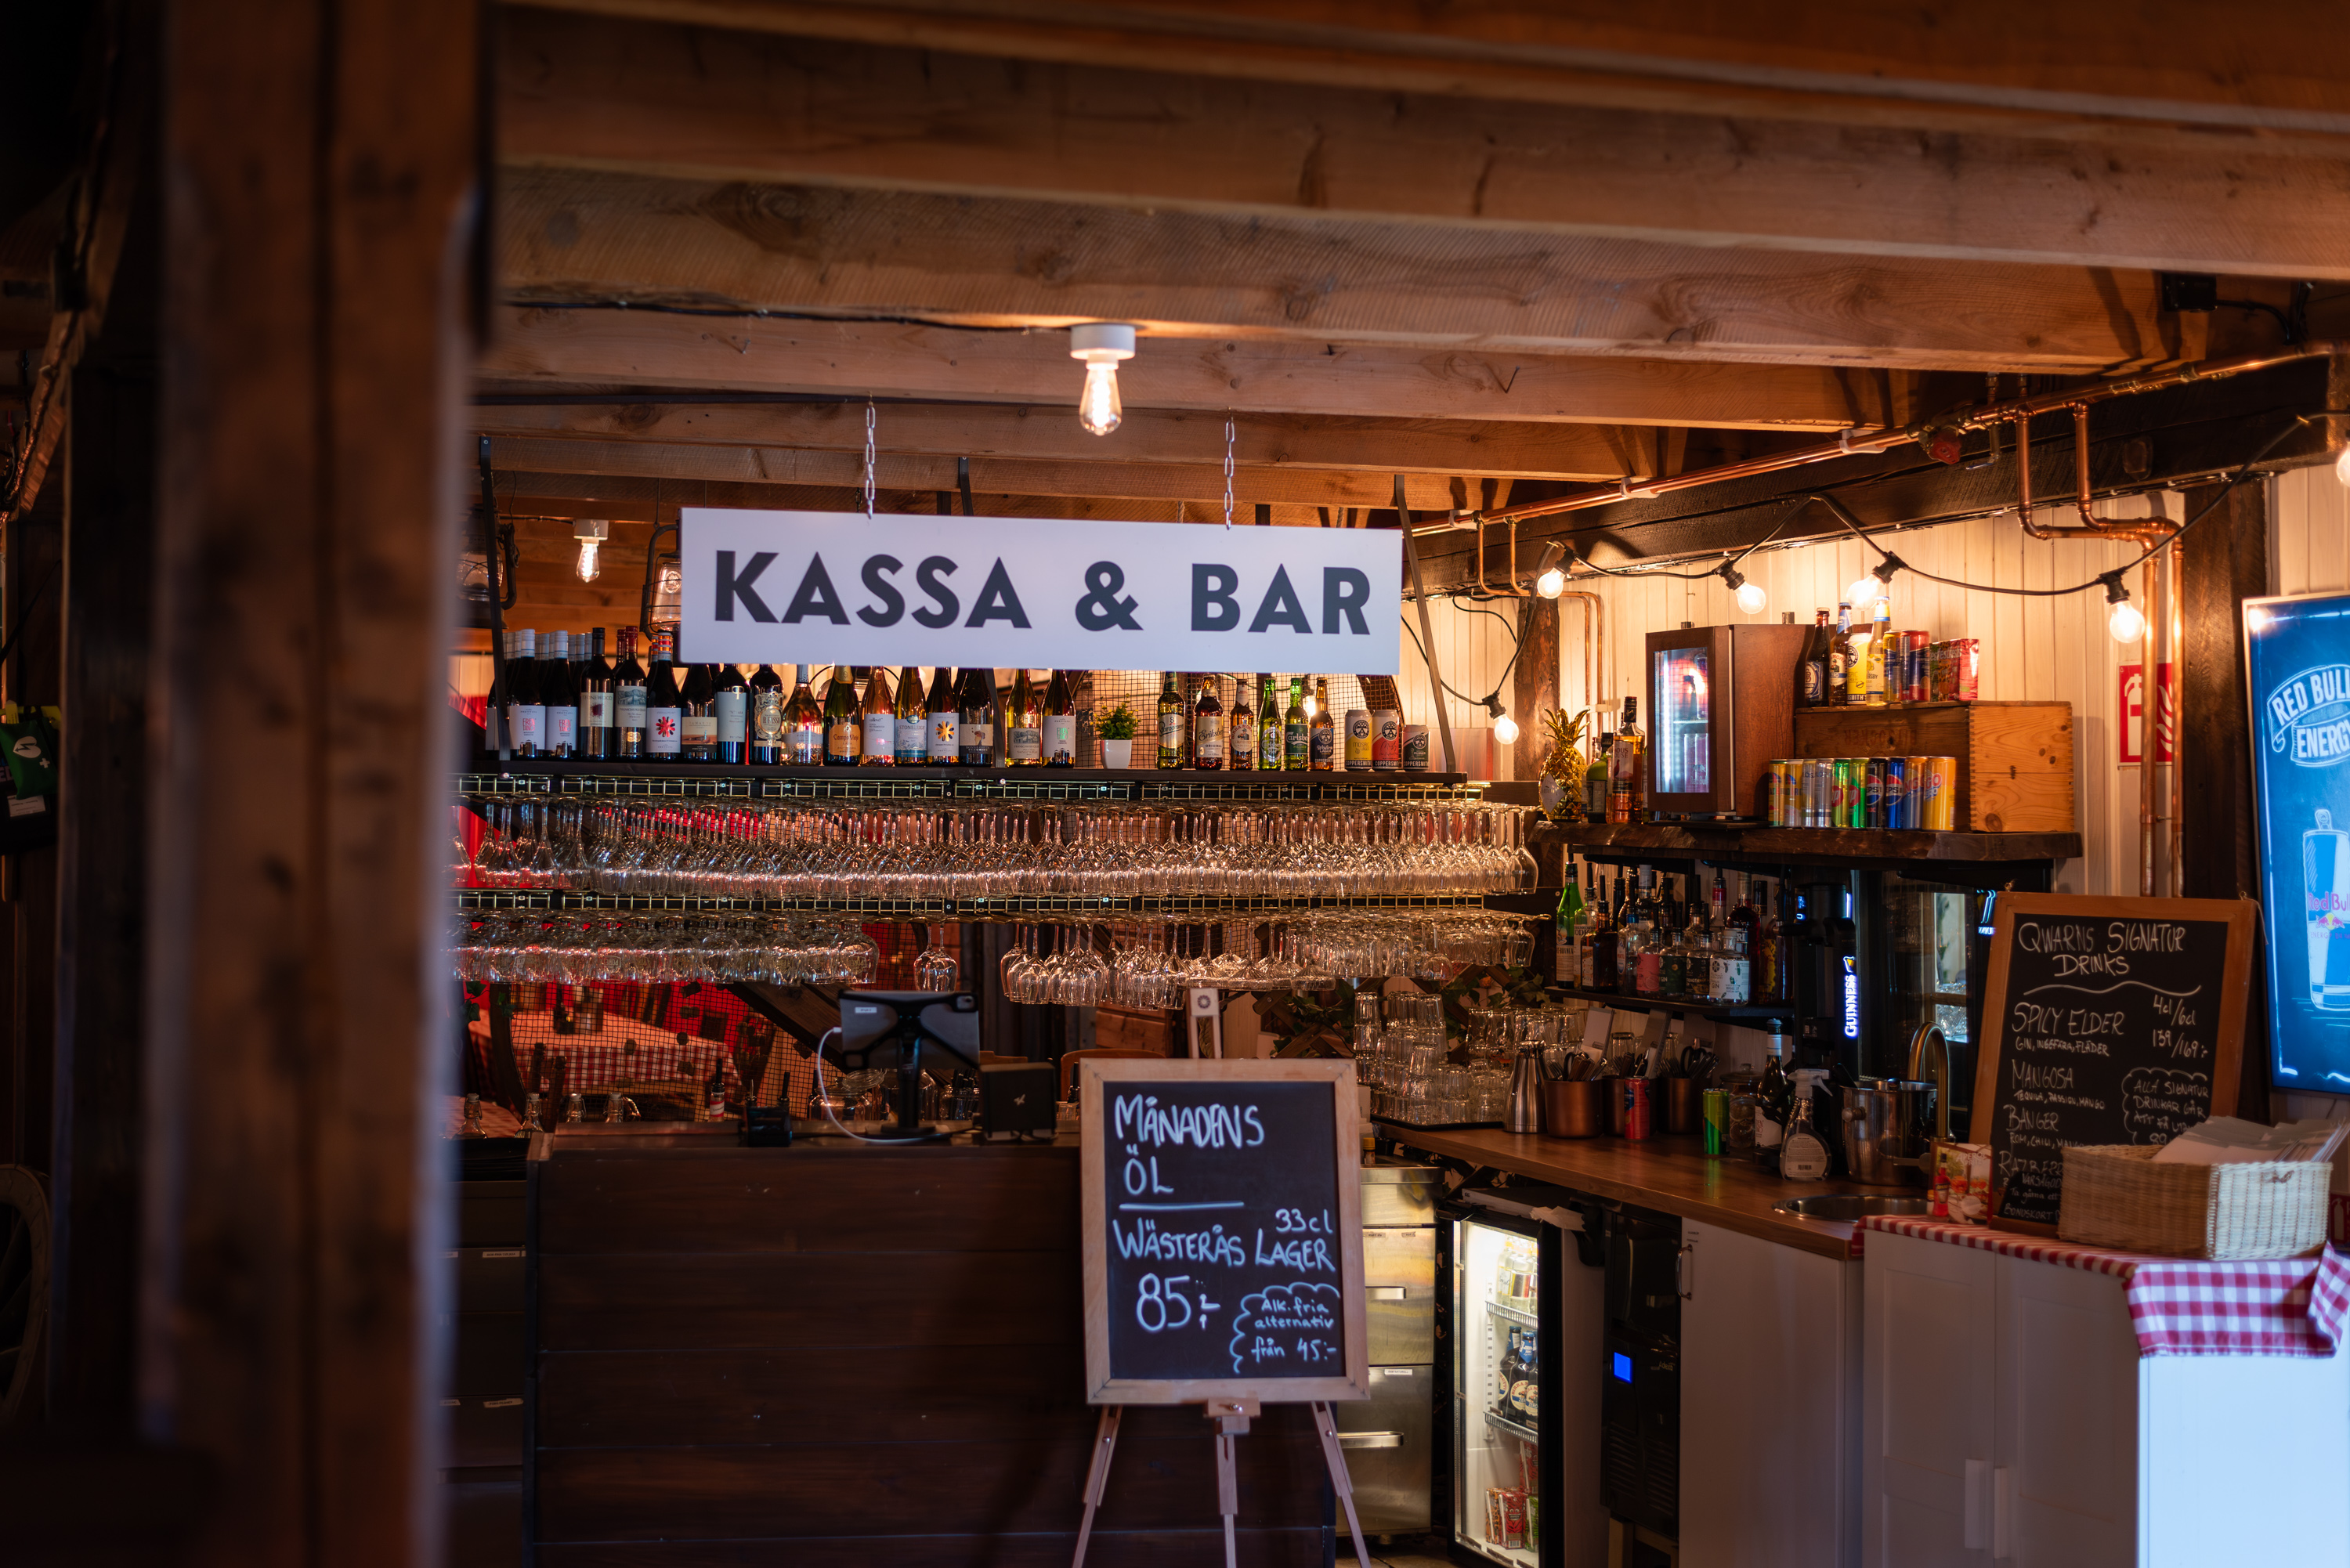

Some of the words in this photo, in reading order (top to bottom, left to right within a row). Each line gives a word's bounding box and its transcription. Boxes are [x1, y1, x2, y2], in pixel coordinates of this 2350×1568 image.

[714, 550, 1032, 629] KASSA
[1076, 560, 1143, 631] &
[1191, 562, 1371, 635] BAR
[2272, 681, 2308, 726] RED
[1198, 728, 1223, 742] Eriksbe
[1285, 732, 1307, 743] Carlsbe
[2308, 891, 2330, 911] Red
[2107, 921, 2186, 953] SIGNATUR
[2052, 953, 2130, 977] DRINKS
[1844, 974, 1857, 1037] GUINNESS
[2012, 1002, 2064, 1035] SPICY
[2068, 1008, 2125, 1036] ELDER
[2011, 1058, 2074, 1089] MANGOSA
[2133, 1078, 2160, 1094] ALLA
[2164, 1081, 2209, 1098] SIGNATUR
[2078, 1097, 2106, 1110] MANGO
[2133, 1095, 2180, 1114] DRINKAR
[2183, 1099, 2207, 1119] GÅR
[1115, 1093, 1264, 1149] MÅNADENS
[2003, 1104, 2059, 1132] BANGER
[2133, 1111, 2155, 1125] ATT
[1123, 1143, 1173, 1196] ÖL
[1275, 1209, 1333, 1234] 33cl
[2004, 1202, 2053, 1220] BONUSKORT
[1112, 1216, 1246, 1266] WÄSTERÅS
[1255, 1227, 1336, 1272] LAGER
[1254, 1315, 1334, 1330] alternativ
[1252, 1337, 1285, 1364] från
[1297, 1338, 1337, 1362] 45:-
